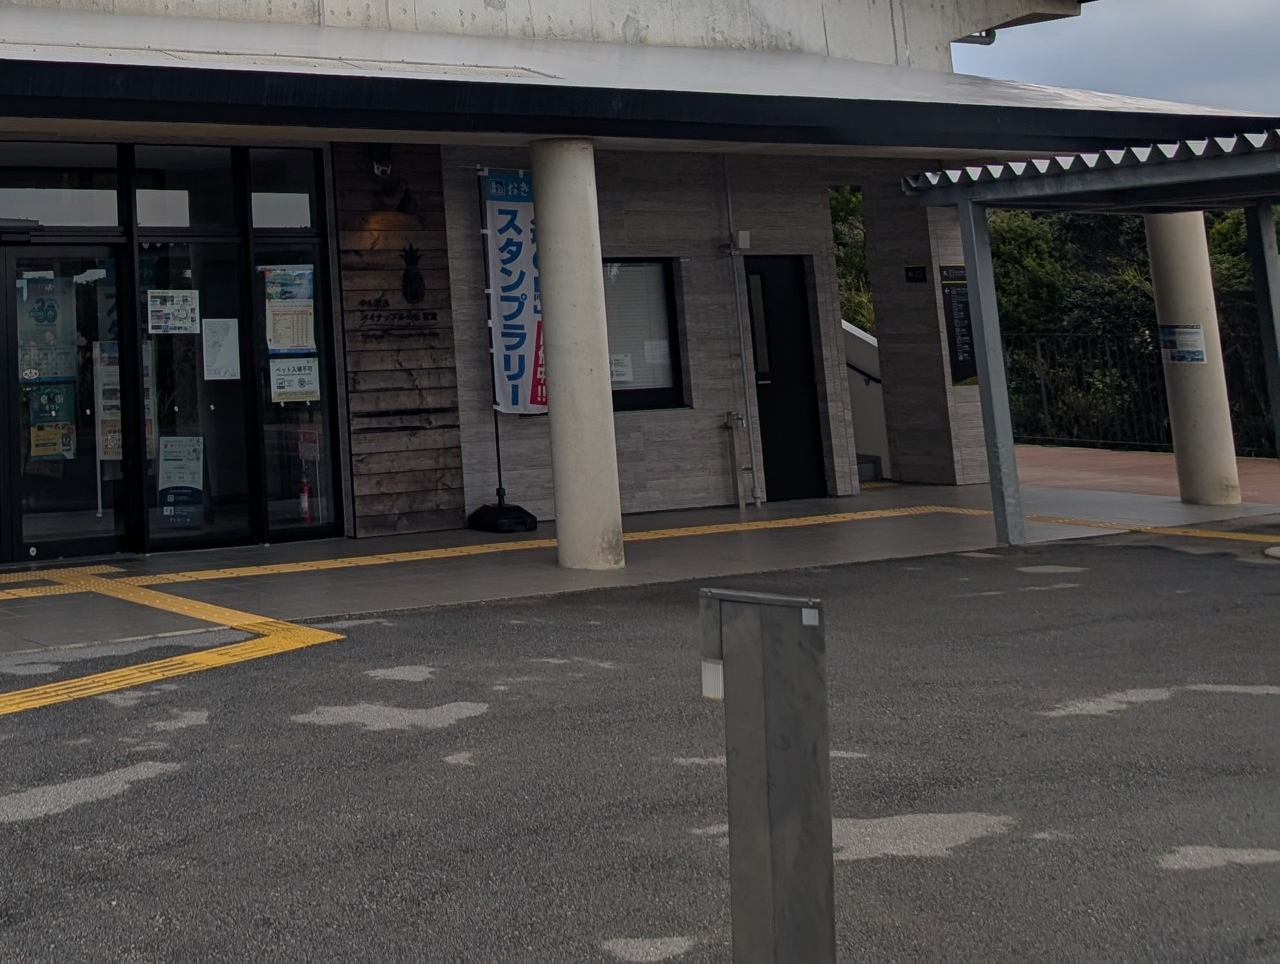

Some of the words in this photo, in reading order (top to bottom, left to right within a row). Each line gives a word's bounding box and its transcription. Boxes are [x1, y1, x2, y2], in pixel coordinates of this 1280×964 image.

[496, 208, 528, 407] スタンプラリー
